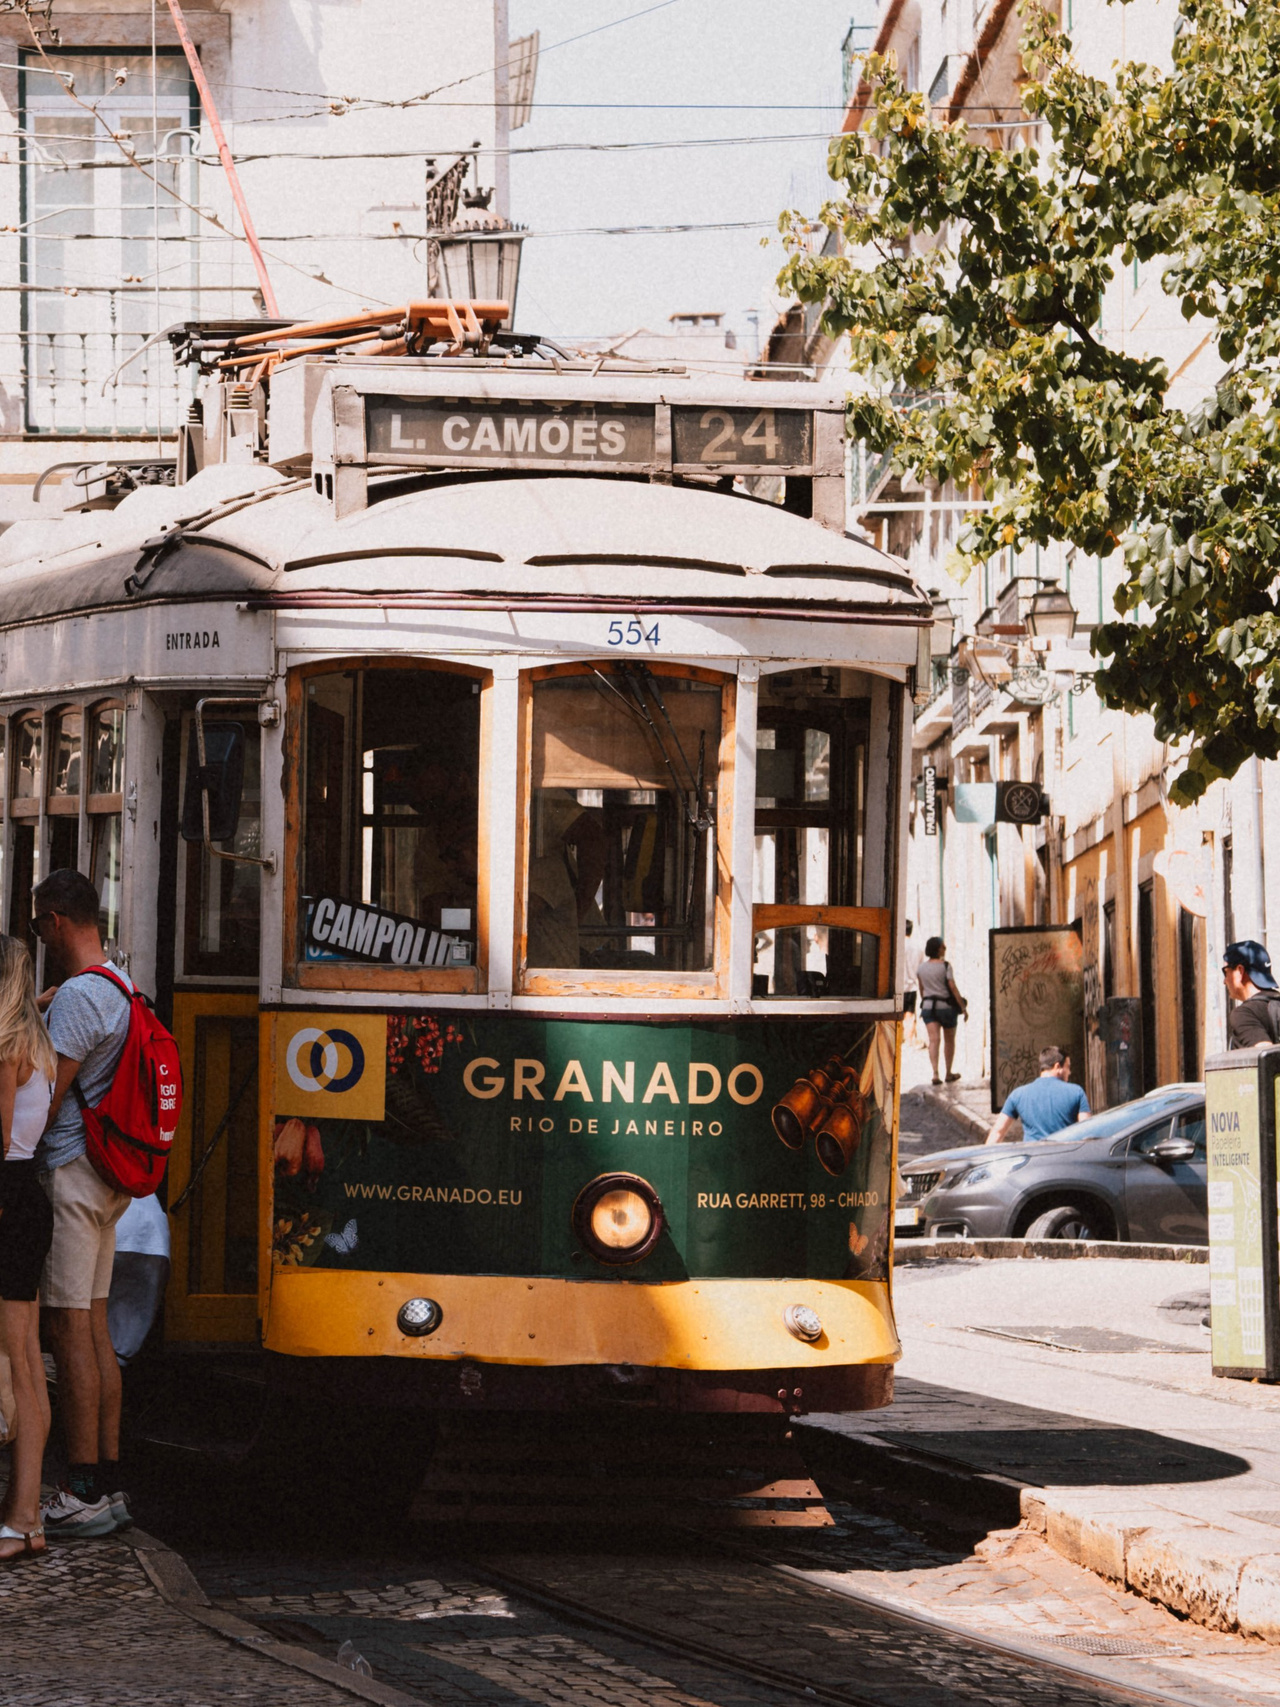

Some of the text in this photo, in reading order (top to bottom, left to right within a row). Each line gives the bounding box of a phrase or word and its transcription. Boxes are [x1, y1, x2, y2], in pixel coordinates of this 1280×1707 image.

[390, 414, 627, 456] L. CAMÕES
[699, 409, 781, 461] 24
[166, 630, 220, 651] ENTRADA
[607, 620, 661, 646] 554
[926, 767, 936, 834] PARLAMENTO
[463, 1057, 764, 1106] GRANADO
[510, 1116, 723, 1137] RIO DE JANEIRO
[1211, 1111, 1240, 1133] NOVA
[1212, 1152, 1250, 1167] INTELIGENTE
[344, 1182, 522, 1206] WWW.GRANADO.EU
[697, 1192, 732, 1208] RUA
[736, 1193, 807, 1211] GARRETT,
[810, 1193, 826, 1208] 98
[838, 1191, 879, 1208] CHIADO
